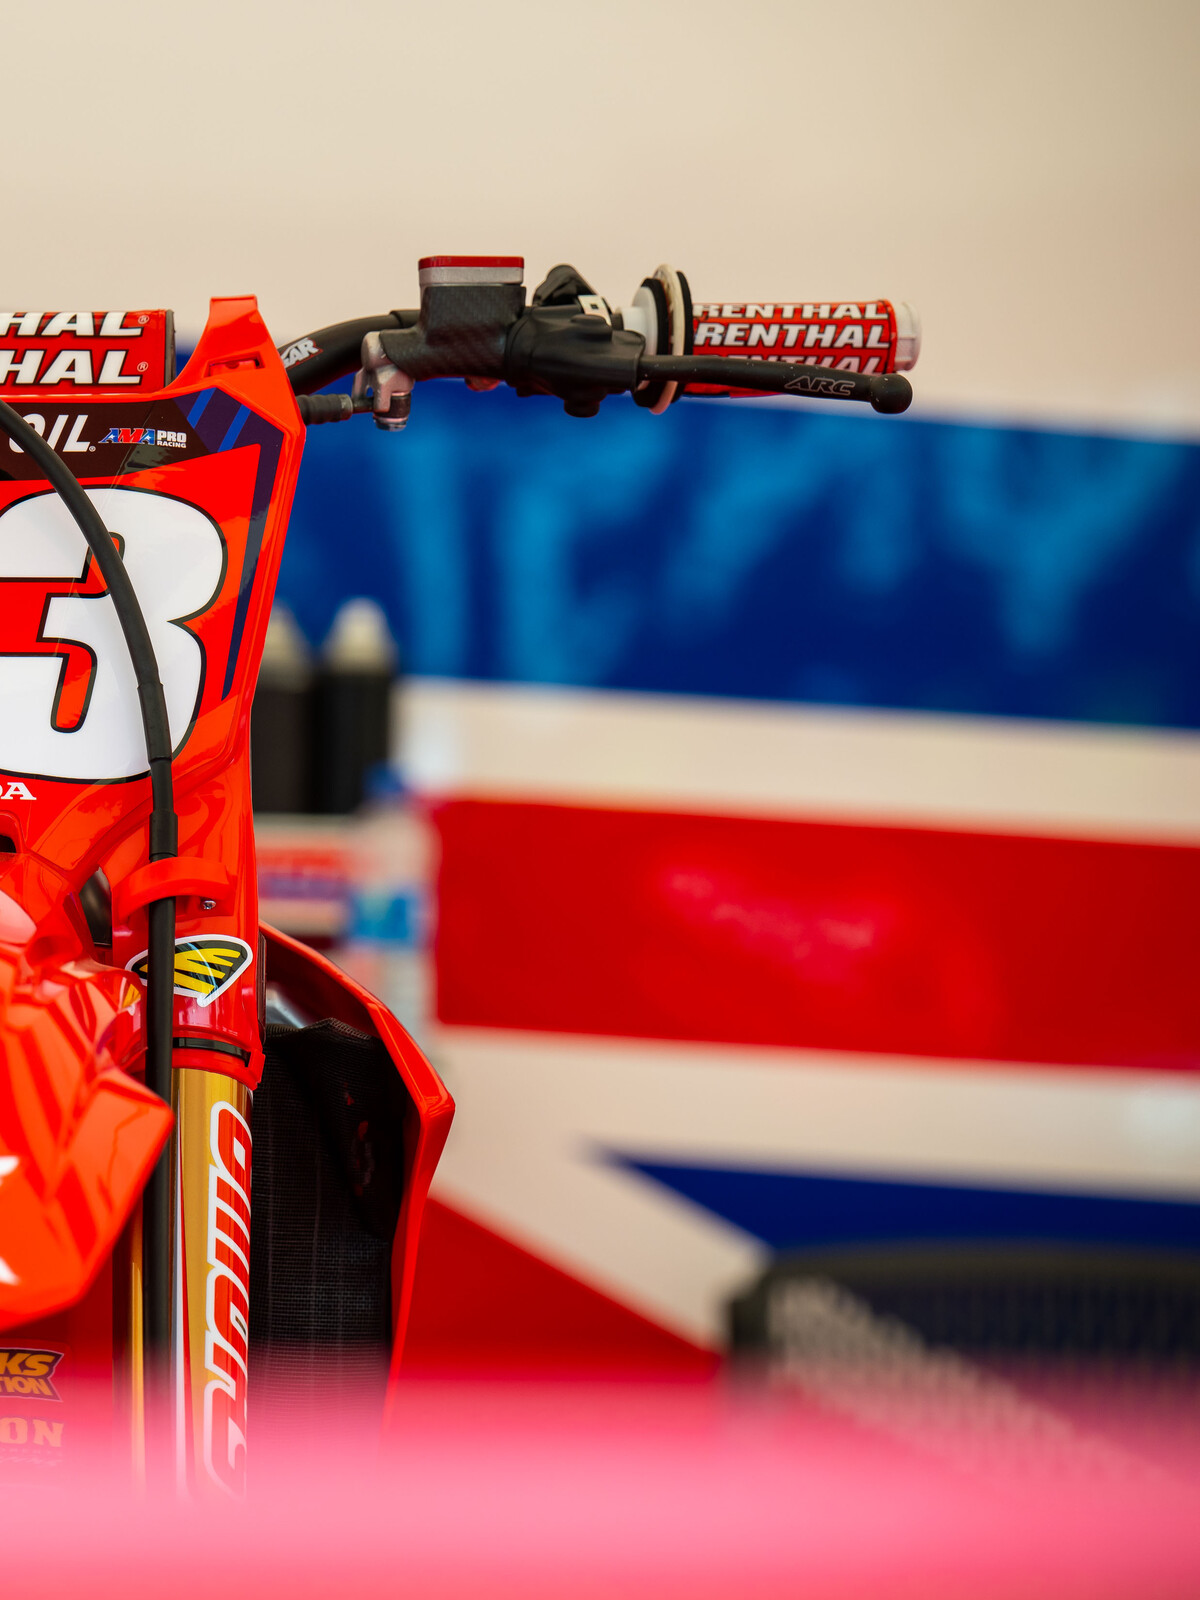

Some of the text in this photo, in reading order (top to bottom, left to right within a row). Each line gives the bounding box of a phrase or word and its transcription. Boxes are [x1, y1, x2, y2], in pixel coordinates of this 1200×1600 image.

[694, 322, 890, 348] RENTHAL
[784, 376, 856, 396] ARC
[98, 428, 187, 445] AMA PRO
[157, 440, 187, 449] RACING
